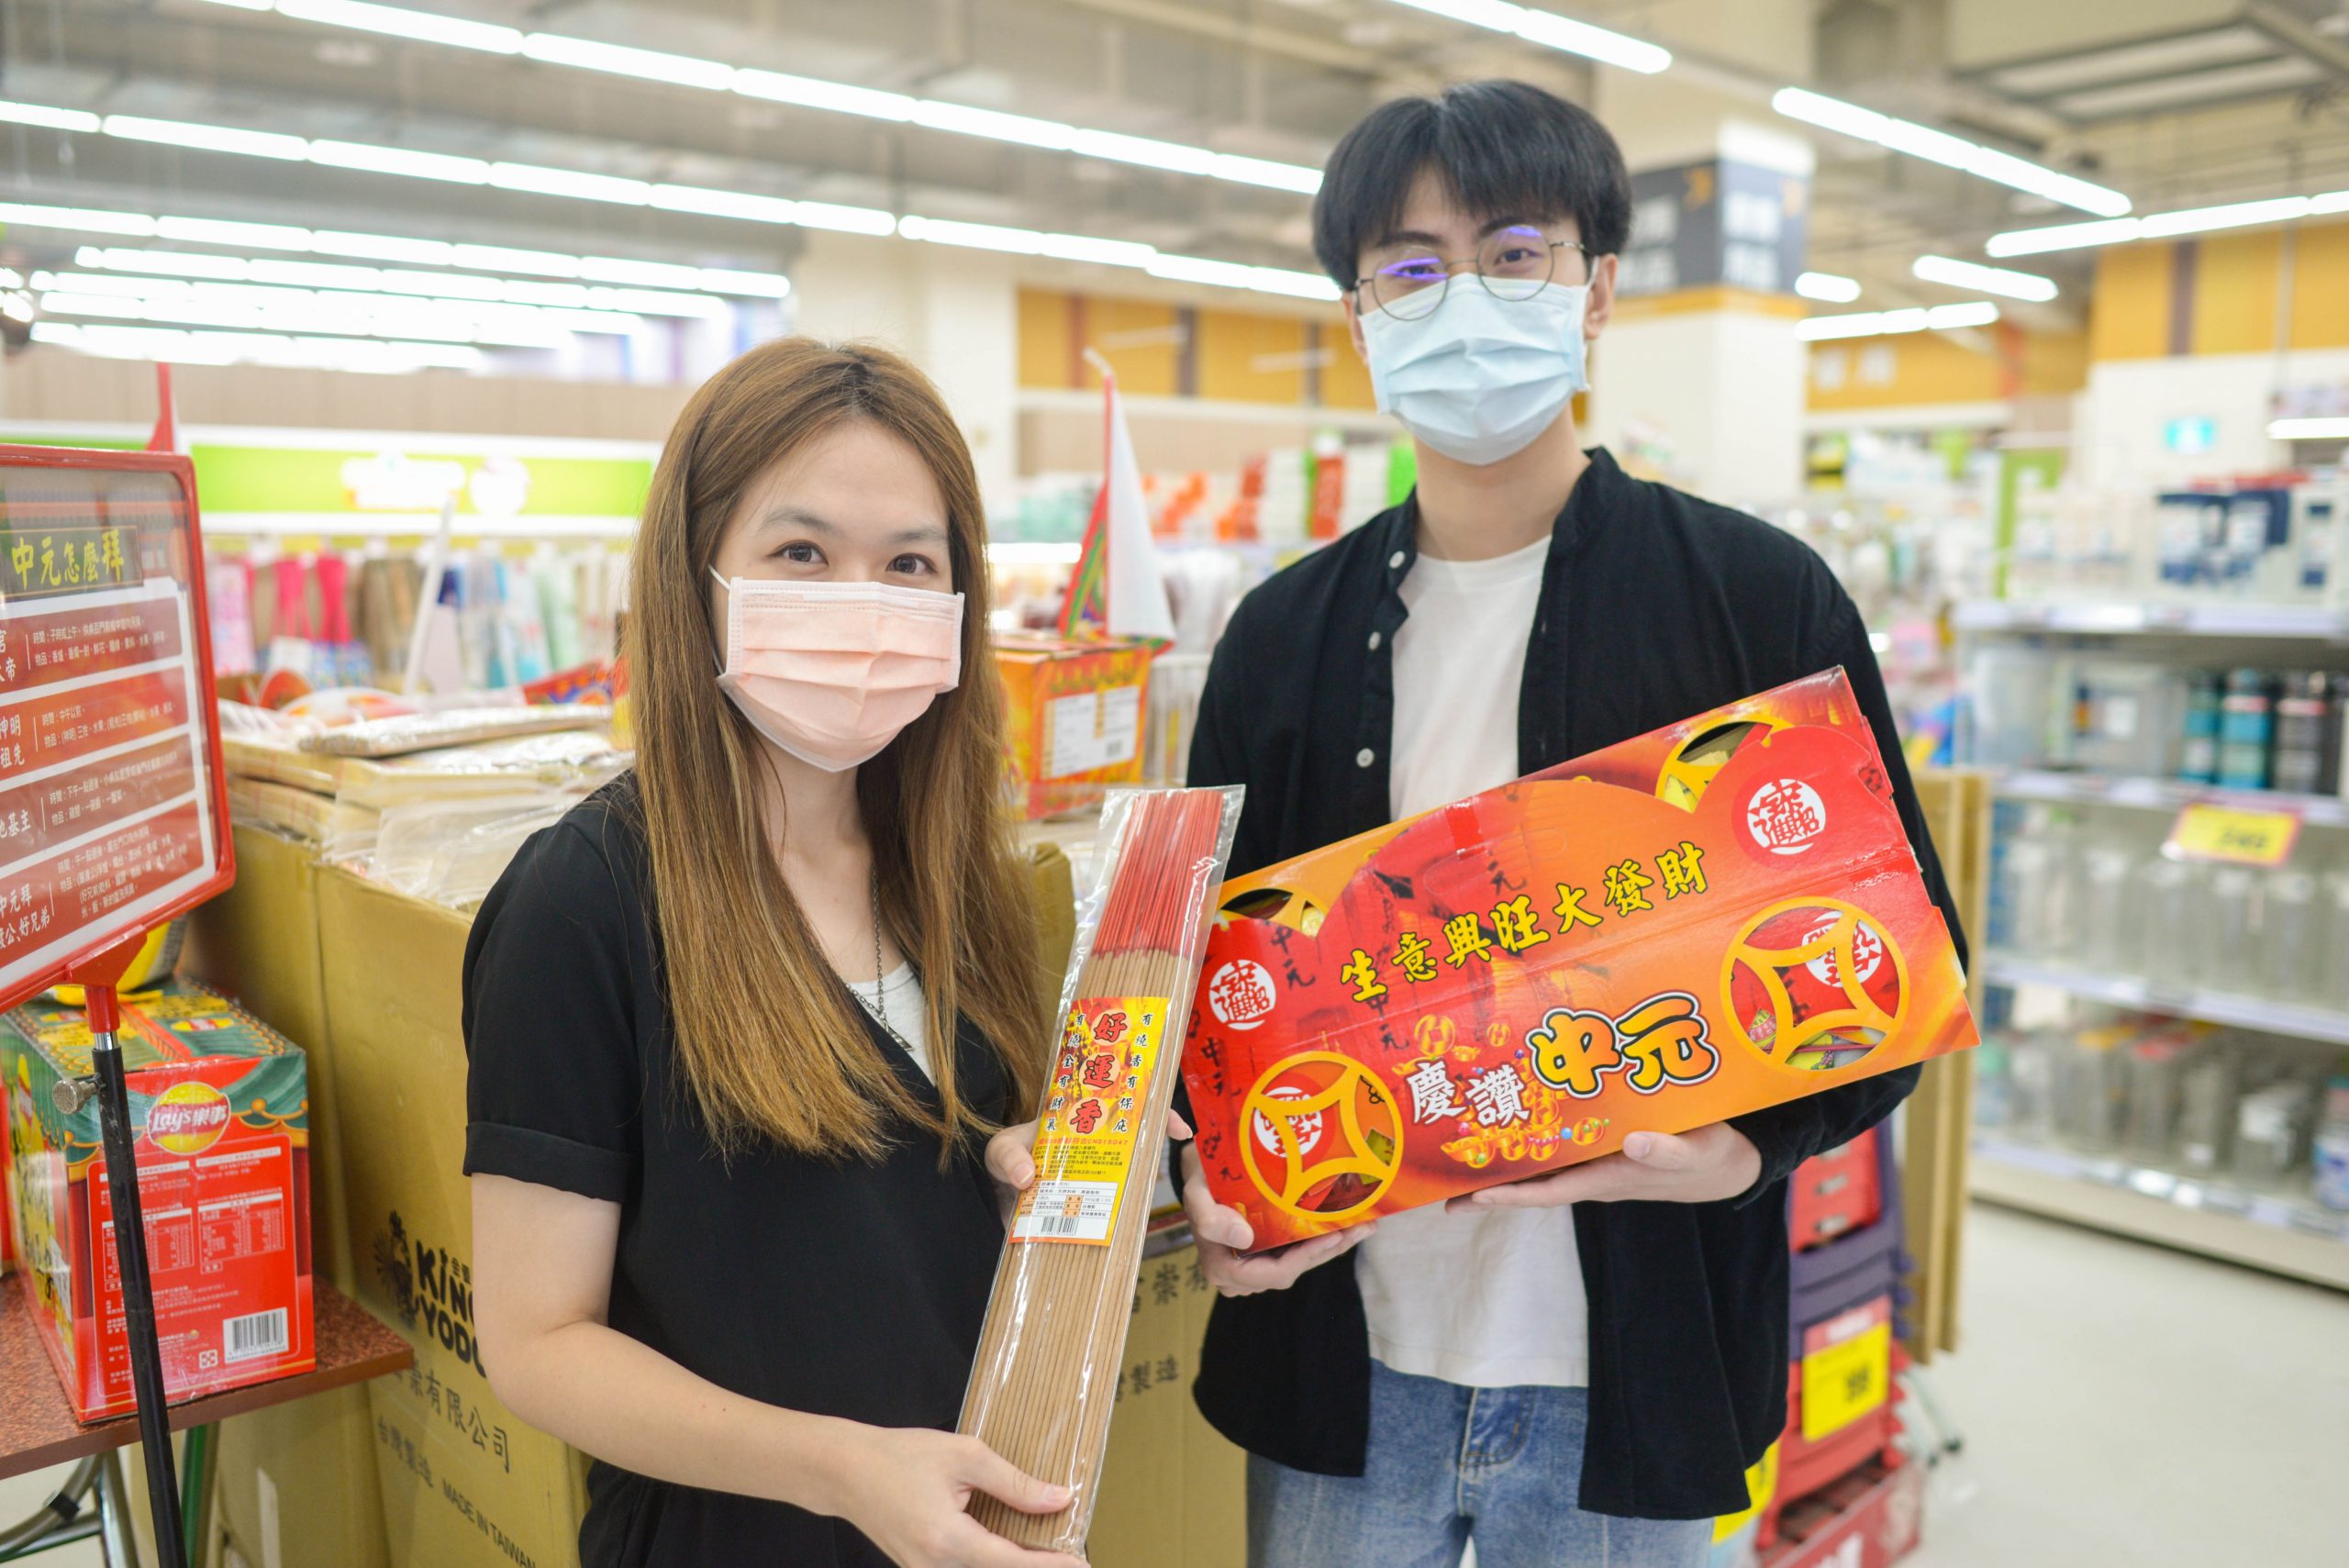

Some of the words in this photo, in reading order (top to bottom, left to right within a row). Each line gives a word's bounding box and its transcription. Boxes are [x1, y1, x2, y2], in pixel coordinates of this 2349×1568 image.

[12, 528, 124, 591] 中元怎麼拜
[1341, 840, 1709, 1003] 生意興旺大發財
[1070, 1012, 1128, 1134] 好運香
[1525, 990, 1722, 1097] 中元
[151, 1111, 190, 1133] Lay's
[192, 1104, 228, 1126] 樂事
[442, 1478, 474, 1523] MADE
[476, 1509, 488, 1536] IN
